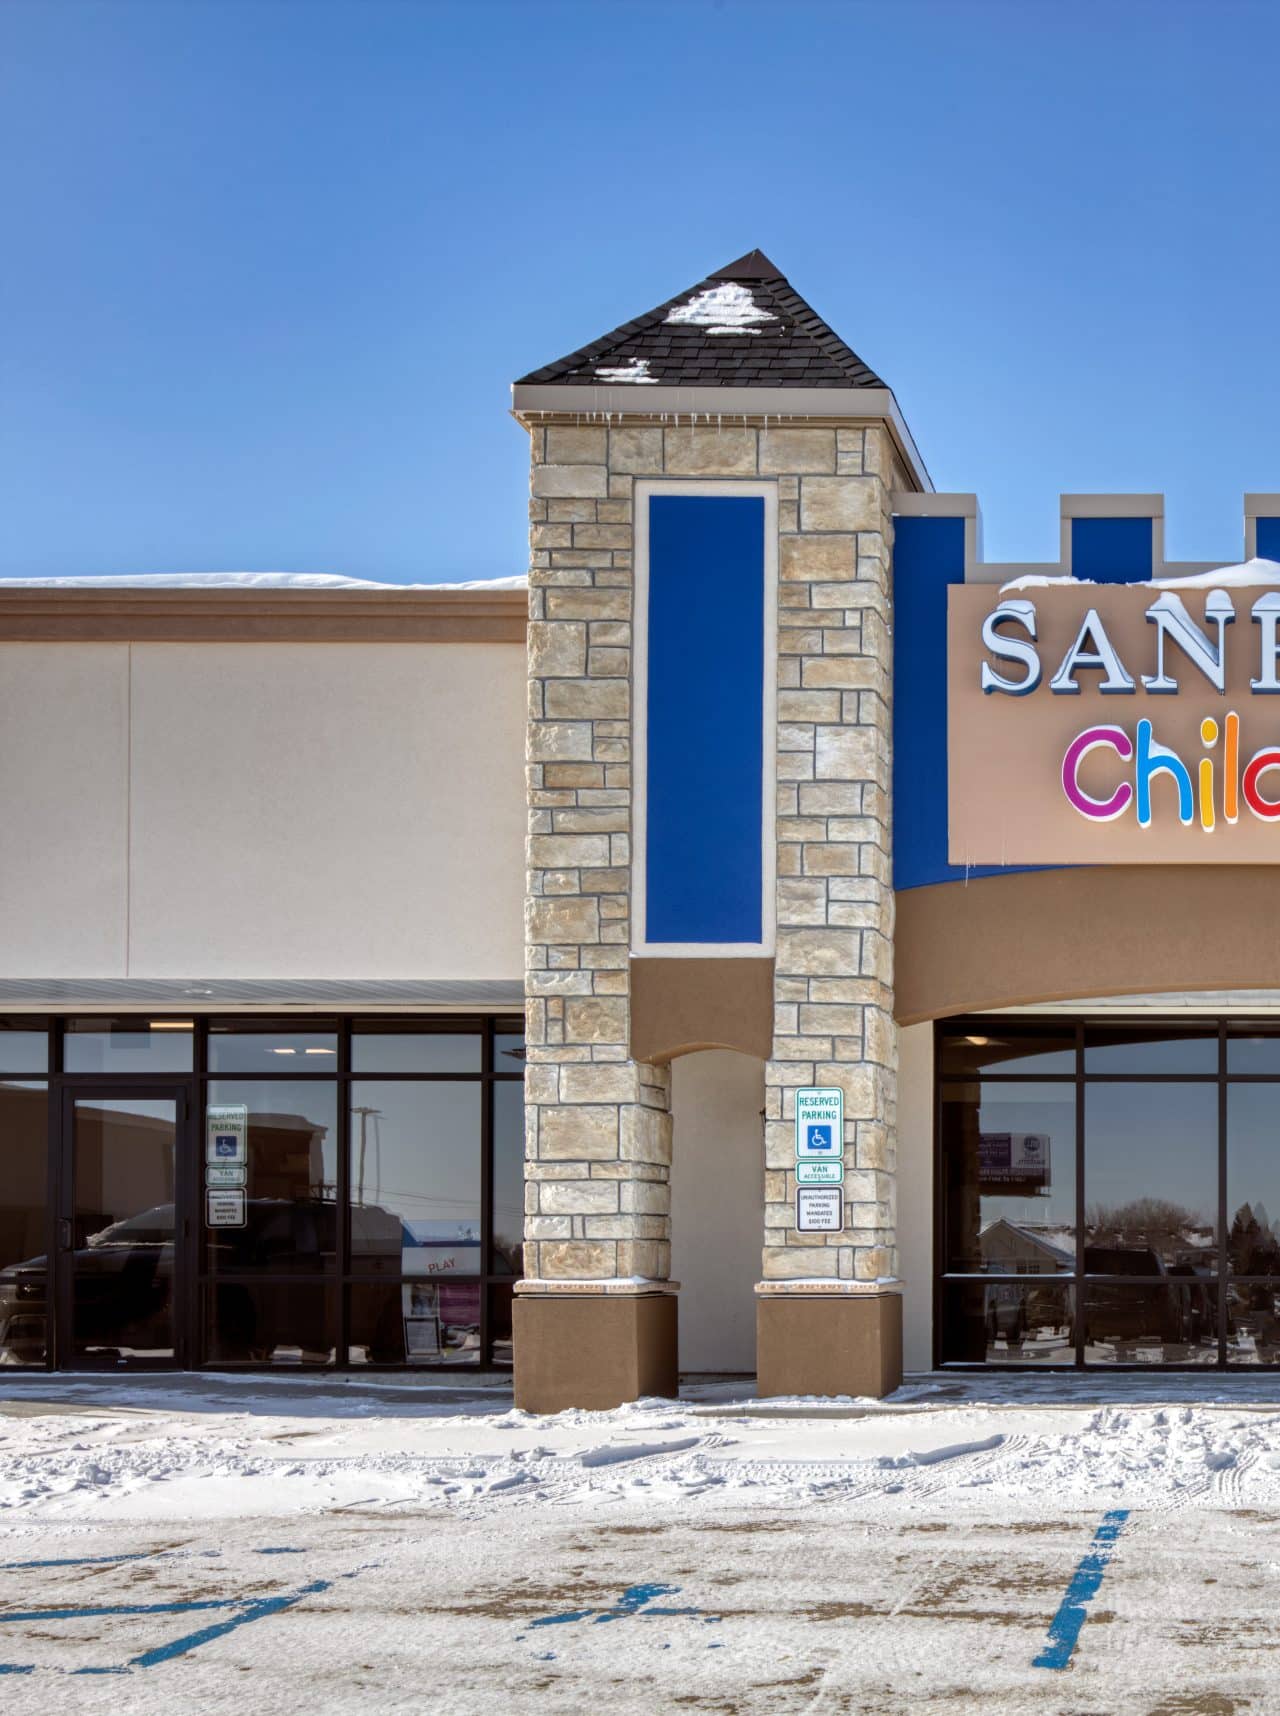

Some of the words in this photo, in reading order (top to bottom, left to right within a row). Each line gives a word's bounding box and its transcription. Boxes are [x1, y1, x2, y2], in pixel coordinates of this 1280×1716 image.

[799, 1097, 839, 1106] RESERVED
[801, 1110, 837, 1120] PARKING
[211, 1124, 242, 1132] PARKING
[811, 1165, 828, 1173] VAN
[427, 1257, 456, 1273] PLAY
